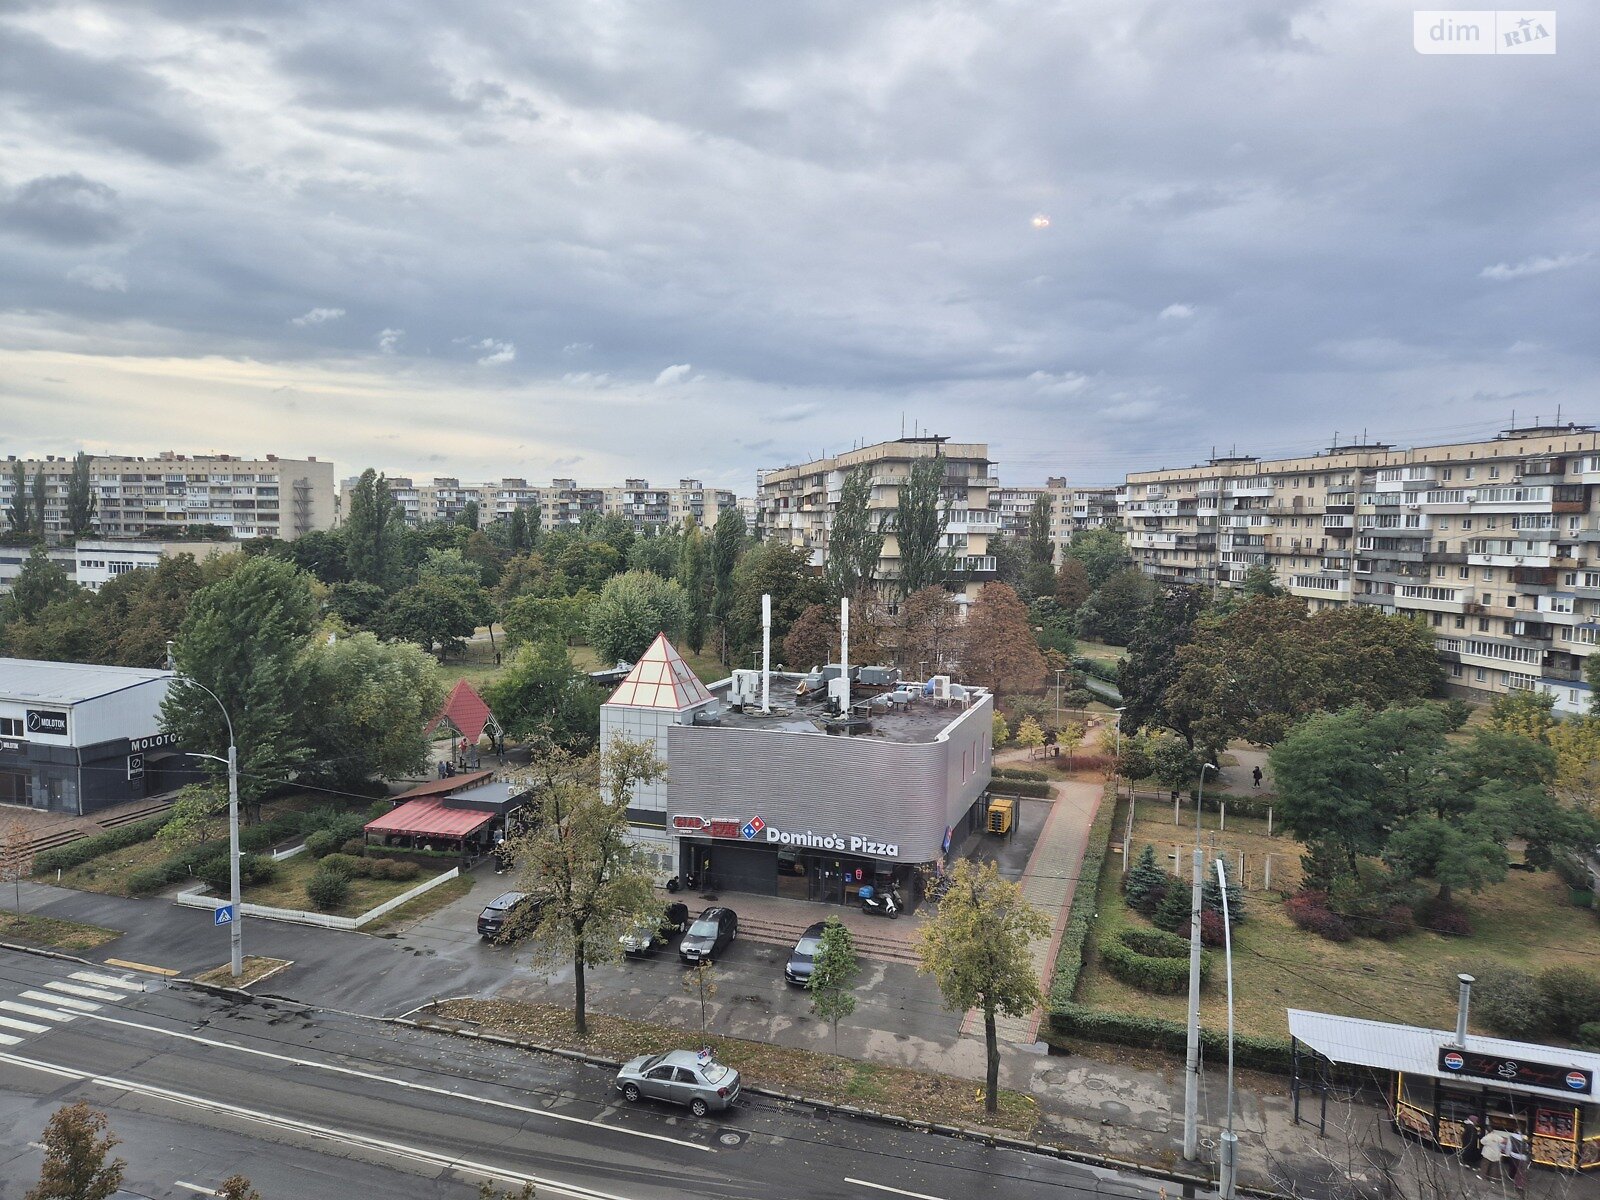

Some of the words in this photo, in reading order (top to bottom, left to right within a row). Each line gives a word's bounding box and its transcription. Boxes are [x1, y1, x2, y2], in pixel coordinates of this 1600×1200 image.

[41, 718, 65, 728] MOLOTOK
[766, 827, 845, 850] Domino's
[850, 836, 898, 857] Pizza
